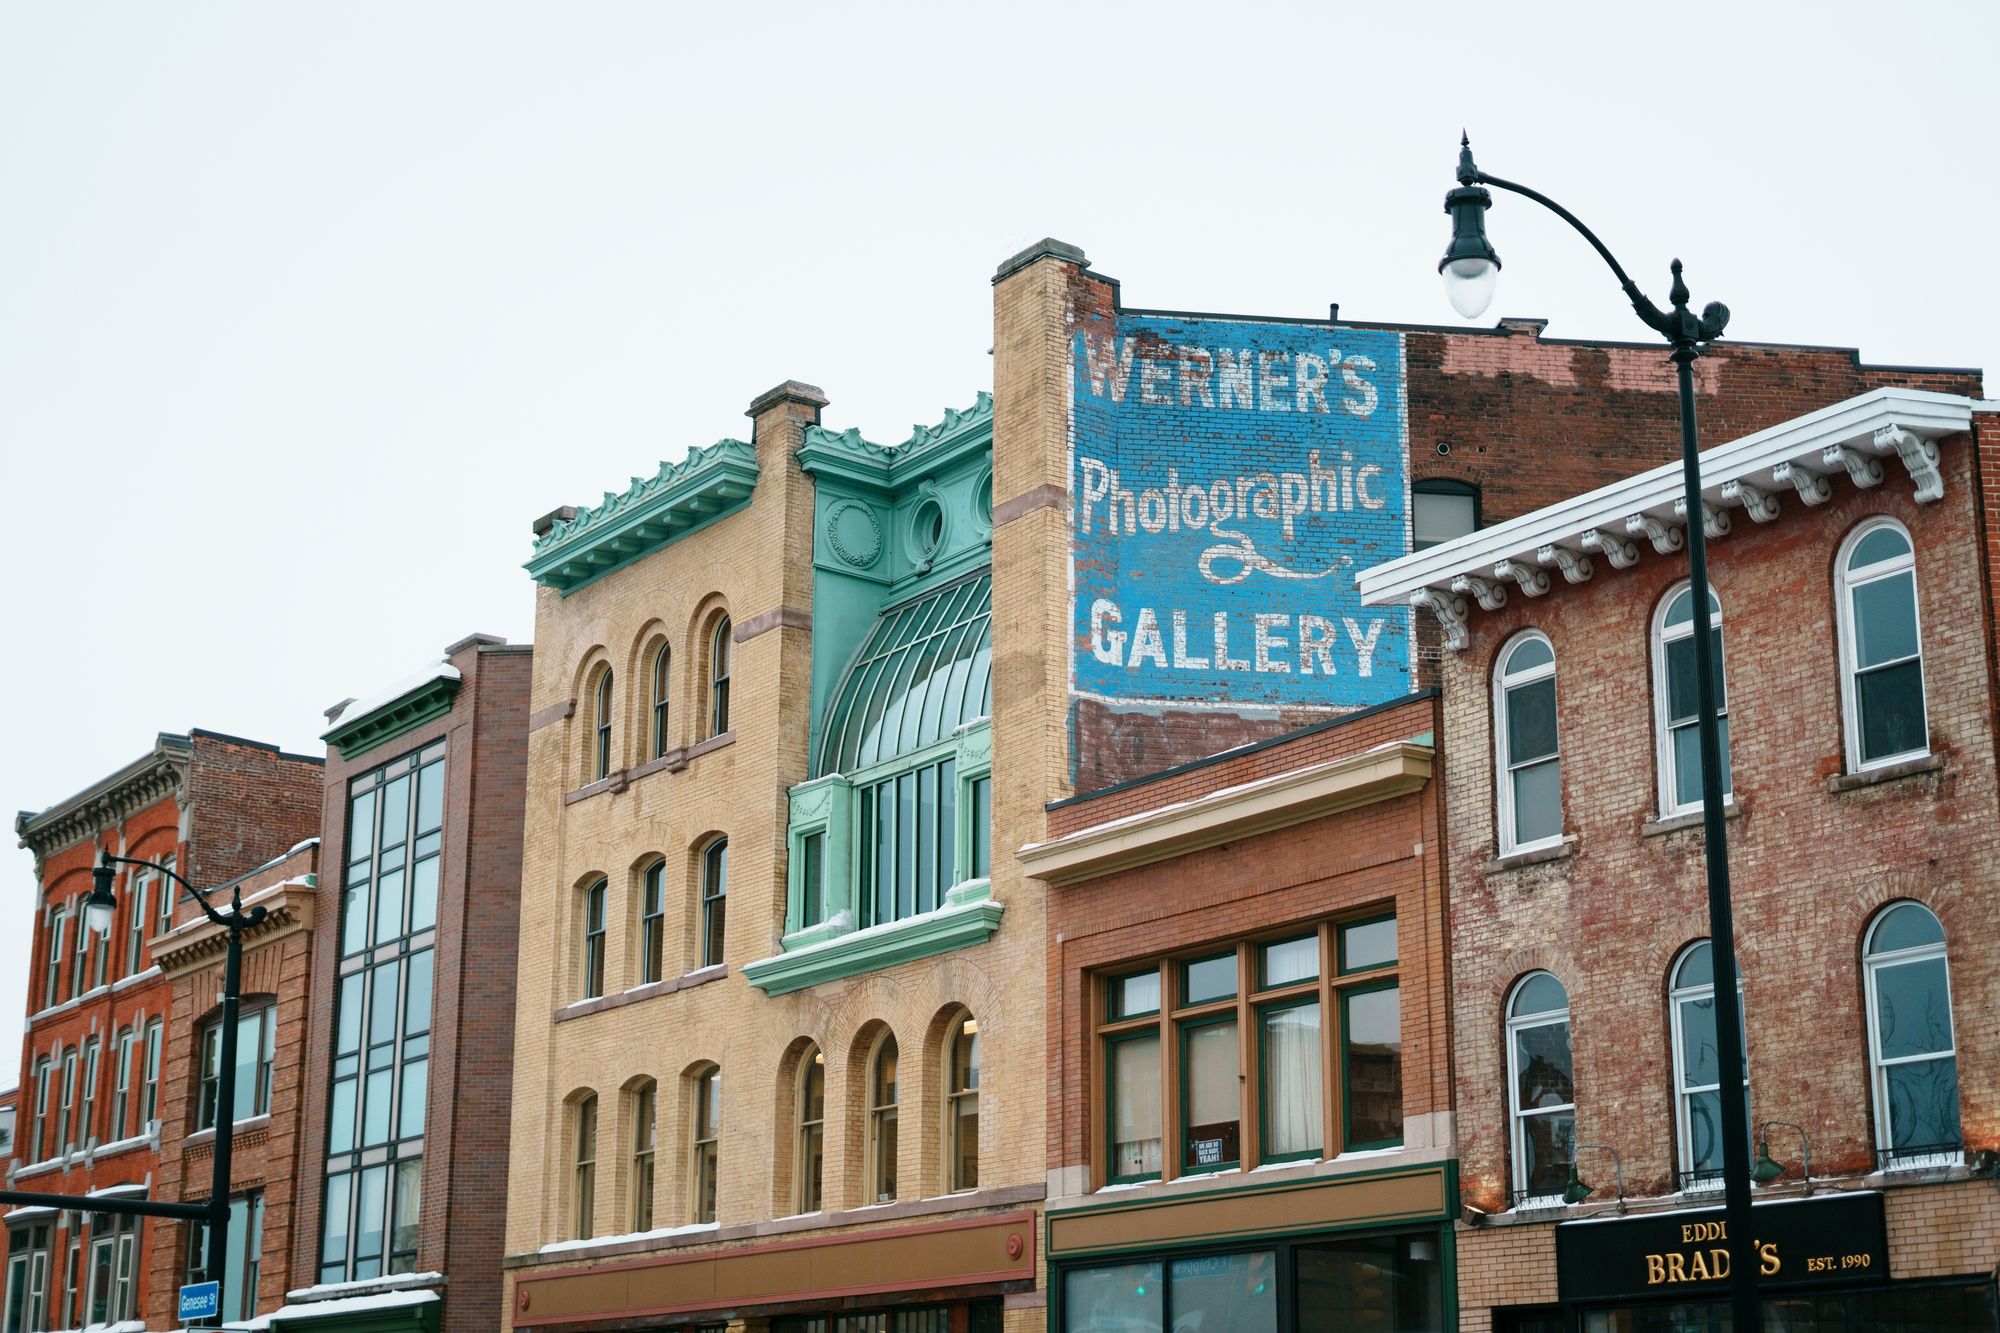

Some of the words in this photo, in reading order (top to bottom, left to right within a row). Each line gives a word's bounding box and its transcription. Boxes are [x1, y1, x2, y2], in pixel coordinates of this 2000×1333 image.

[1083, 329, 1379, 416] WERNER'S
[1080, 449, 1387, 585] Photographic
[1089, 598, 1386, 677] GALLERY
[1199, 1154, 1220, 1163] YEAH!
[1681, 1221, 1728, 1243] EDDI
[1645, 1239, 1781, 1284] BRAD'S
[1807, 1256, 1837, 1272] EST.
[1841, 1253, 1871, 1269] 1990
[182, 1295, 208, 1311] Genesee
[209, 1293, 215, 1305] St
